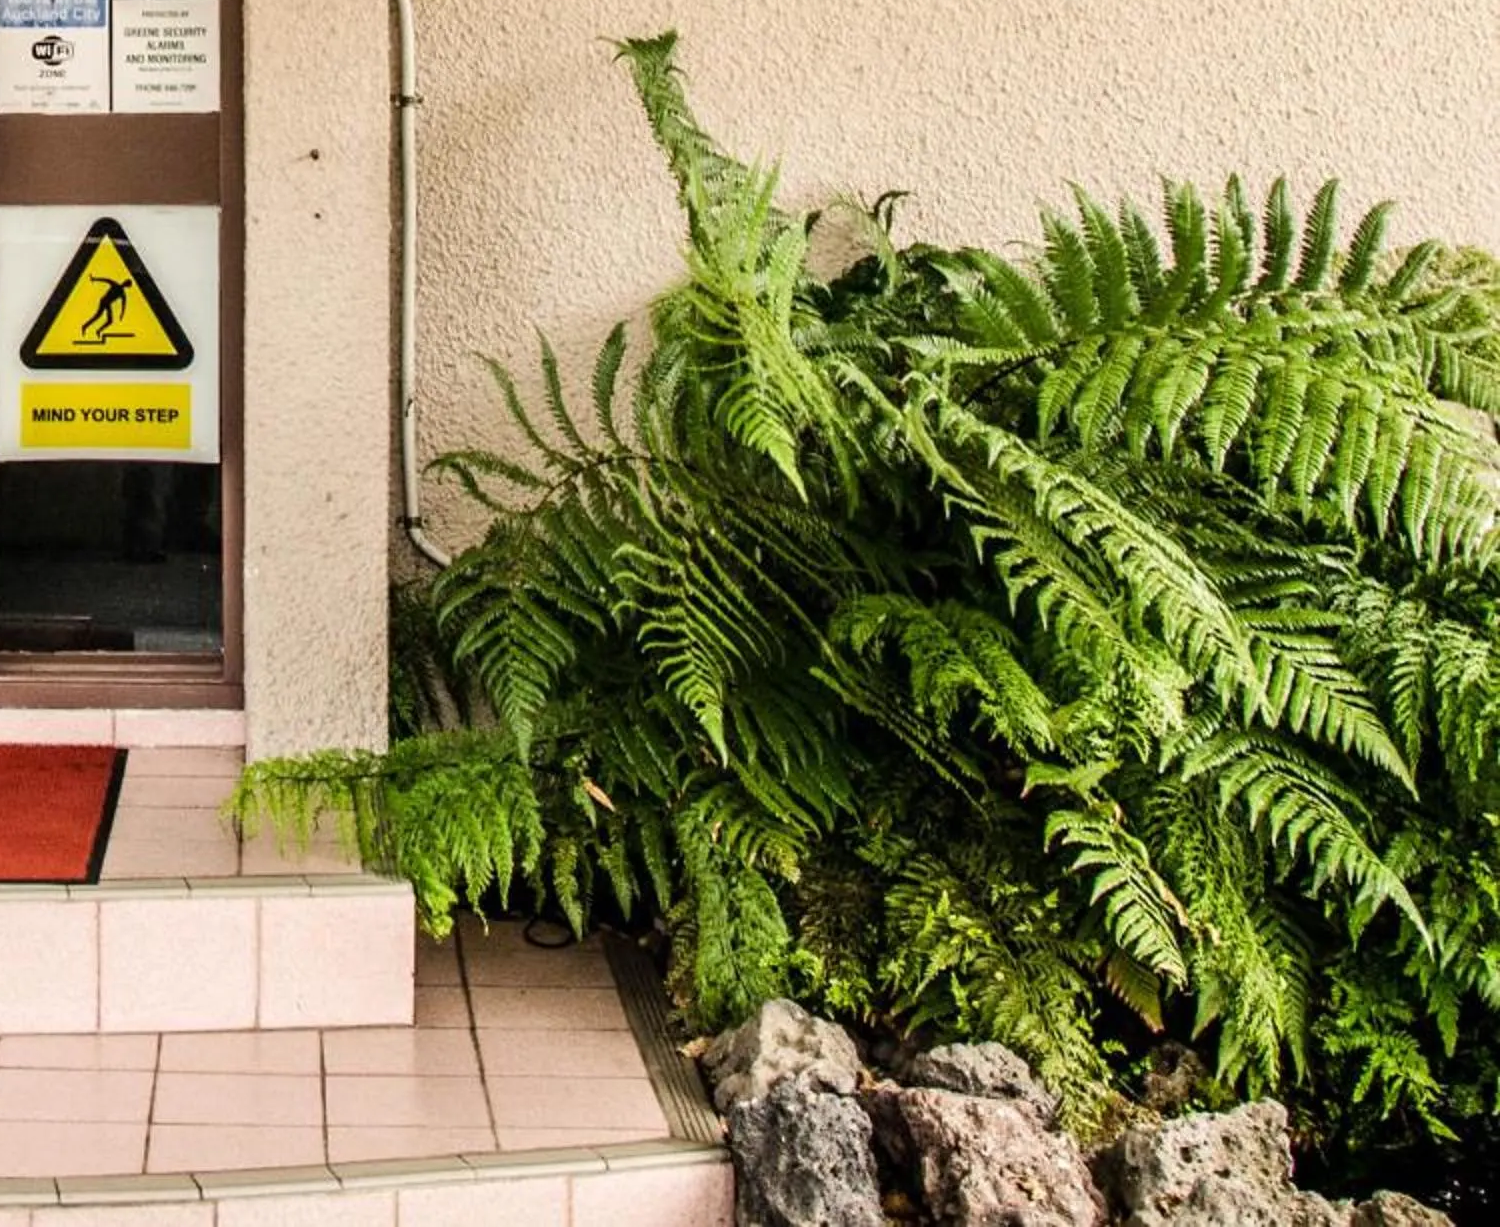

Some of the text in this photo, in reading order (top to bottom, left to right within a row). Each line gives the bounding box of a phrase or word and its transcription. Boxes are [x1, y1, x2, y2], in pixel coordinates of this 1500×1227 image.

[2, 8, 101, 22] Auckland City
[163, 27, 207, 37] SECURITY
[125, 53, 207, 64] AND MONITORING
[39, 69, 66, 78] ZONE
[32, 408, 180, 423] MIND YOUR STEP
